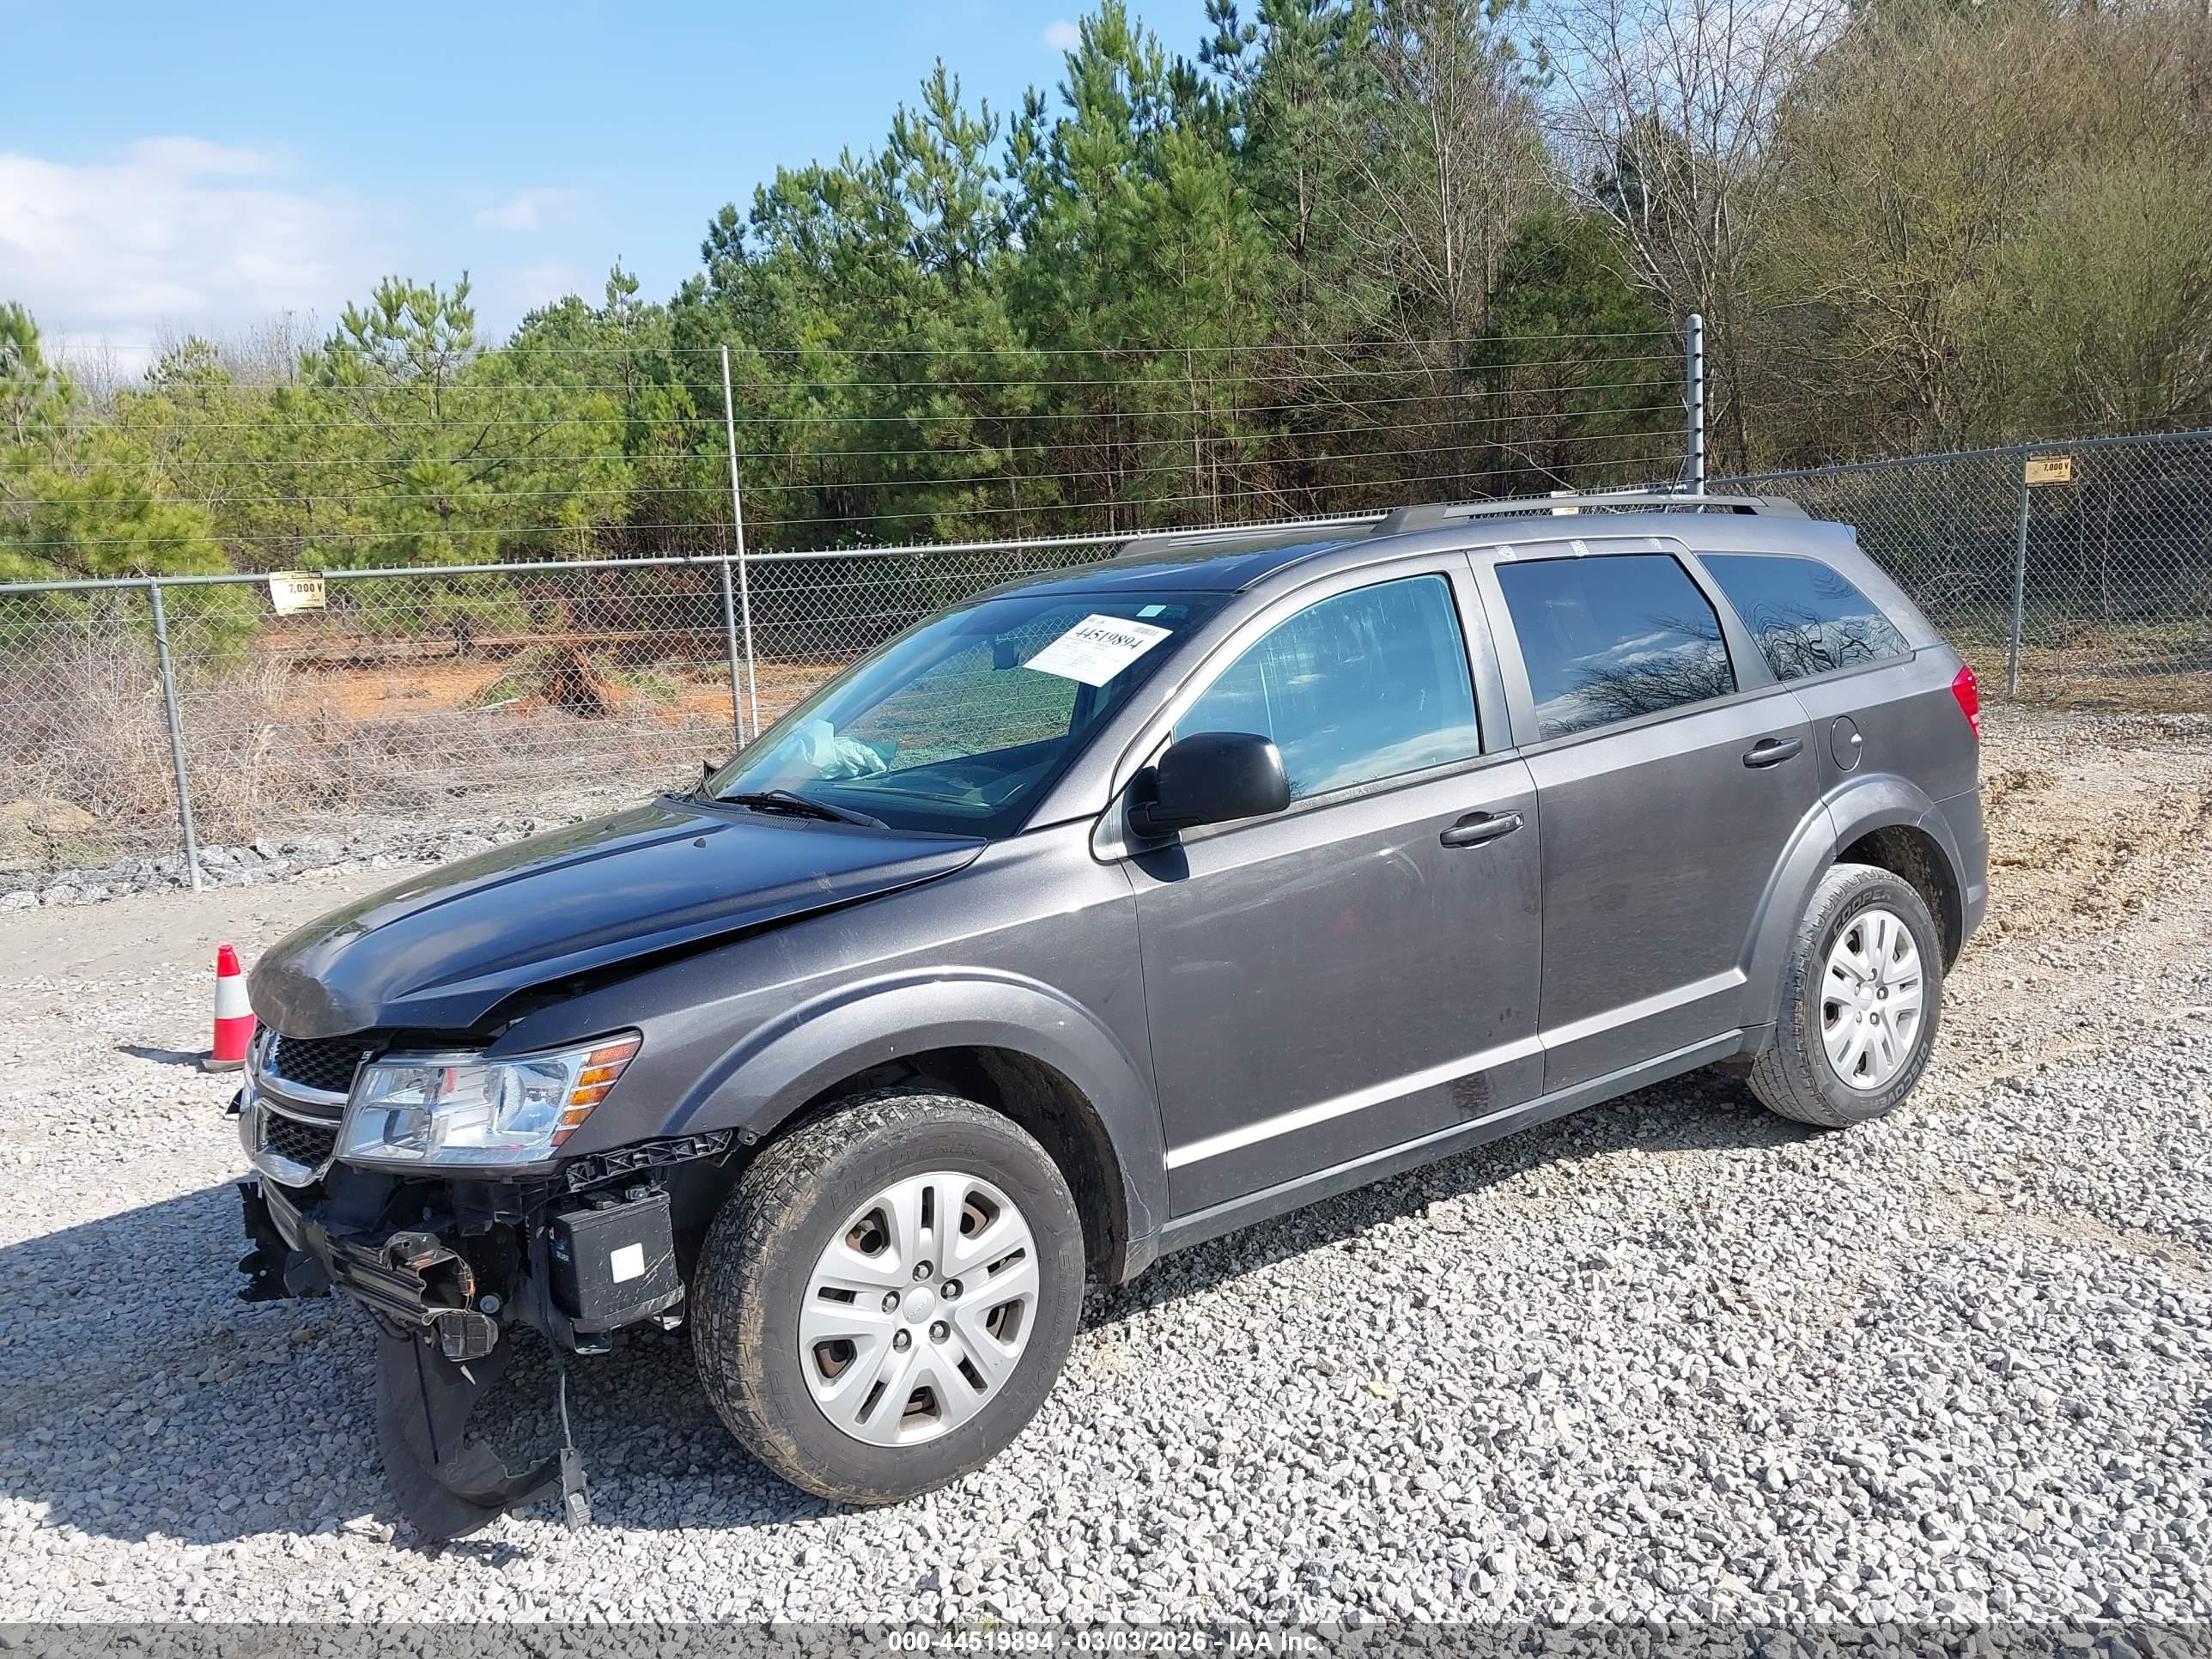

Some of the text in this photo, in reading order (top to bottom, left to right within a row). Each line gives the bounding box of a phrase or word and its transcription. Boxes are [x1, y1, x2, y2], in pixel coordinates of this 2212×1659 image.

[2044, 463, 2063, 472] 7,000
[289, 583, 323, 593] 7,000 V
[1076, 627, 1145, 649] 44519894
[1833, 888, 1893, 936] COOPER
